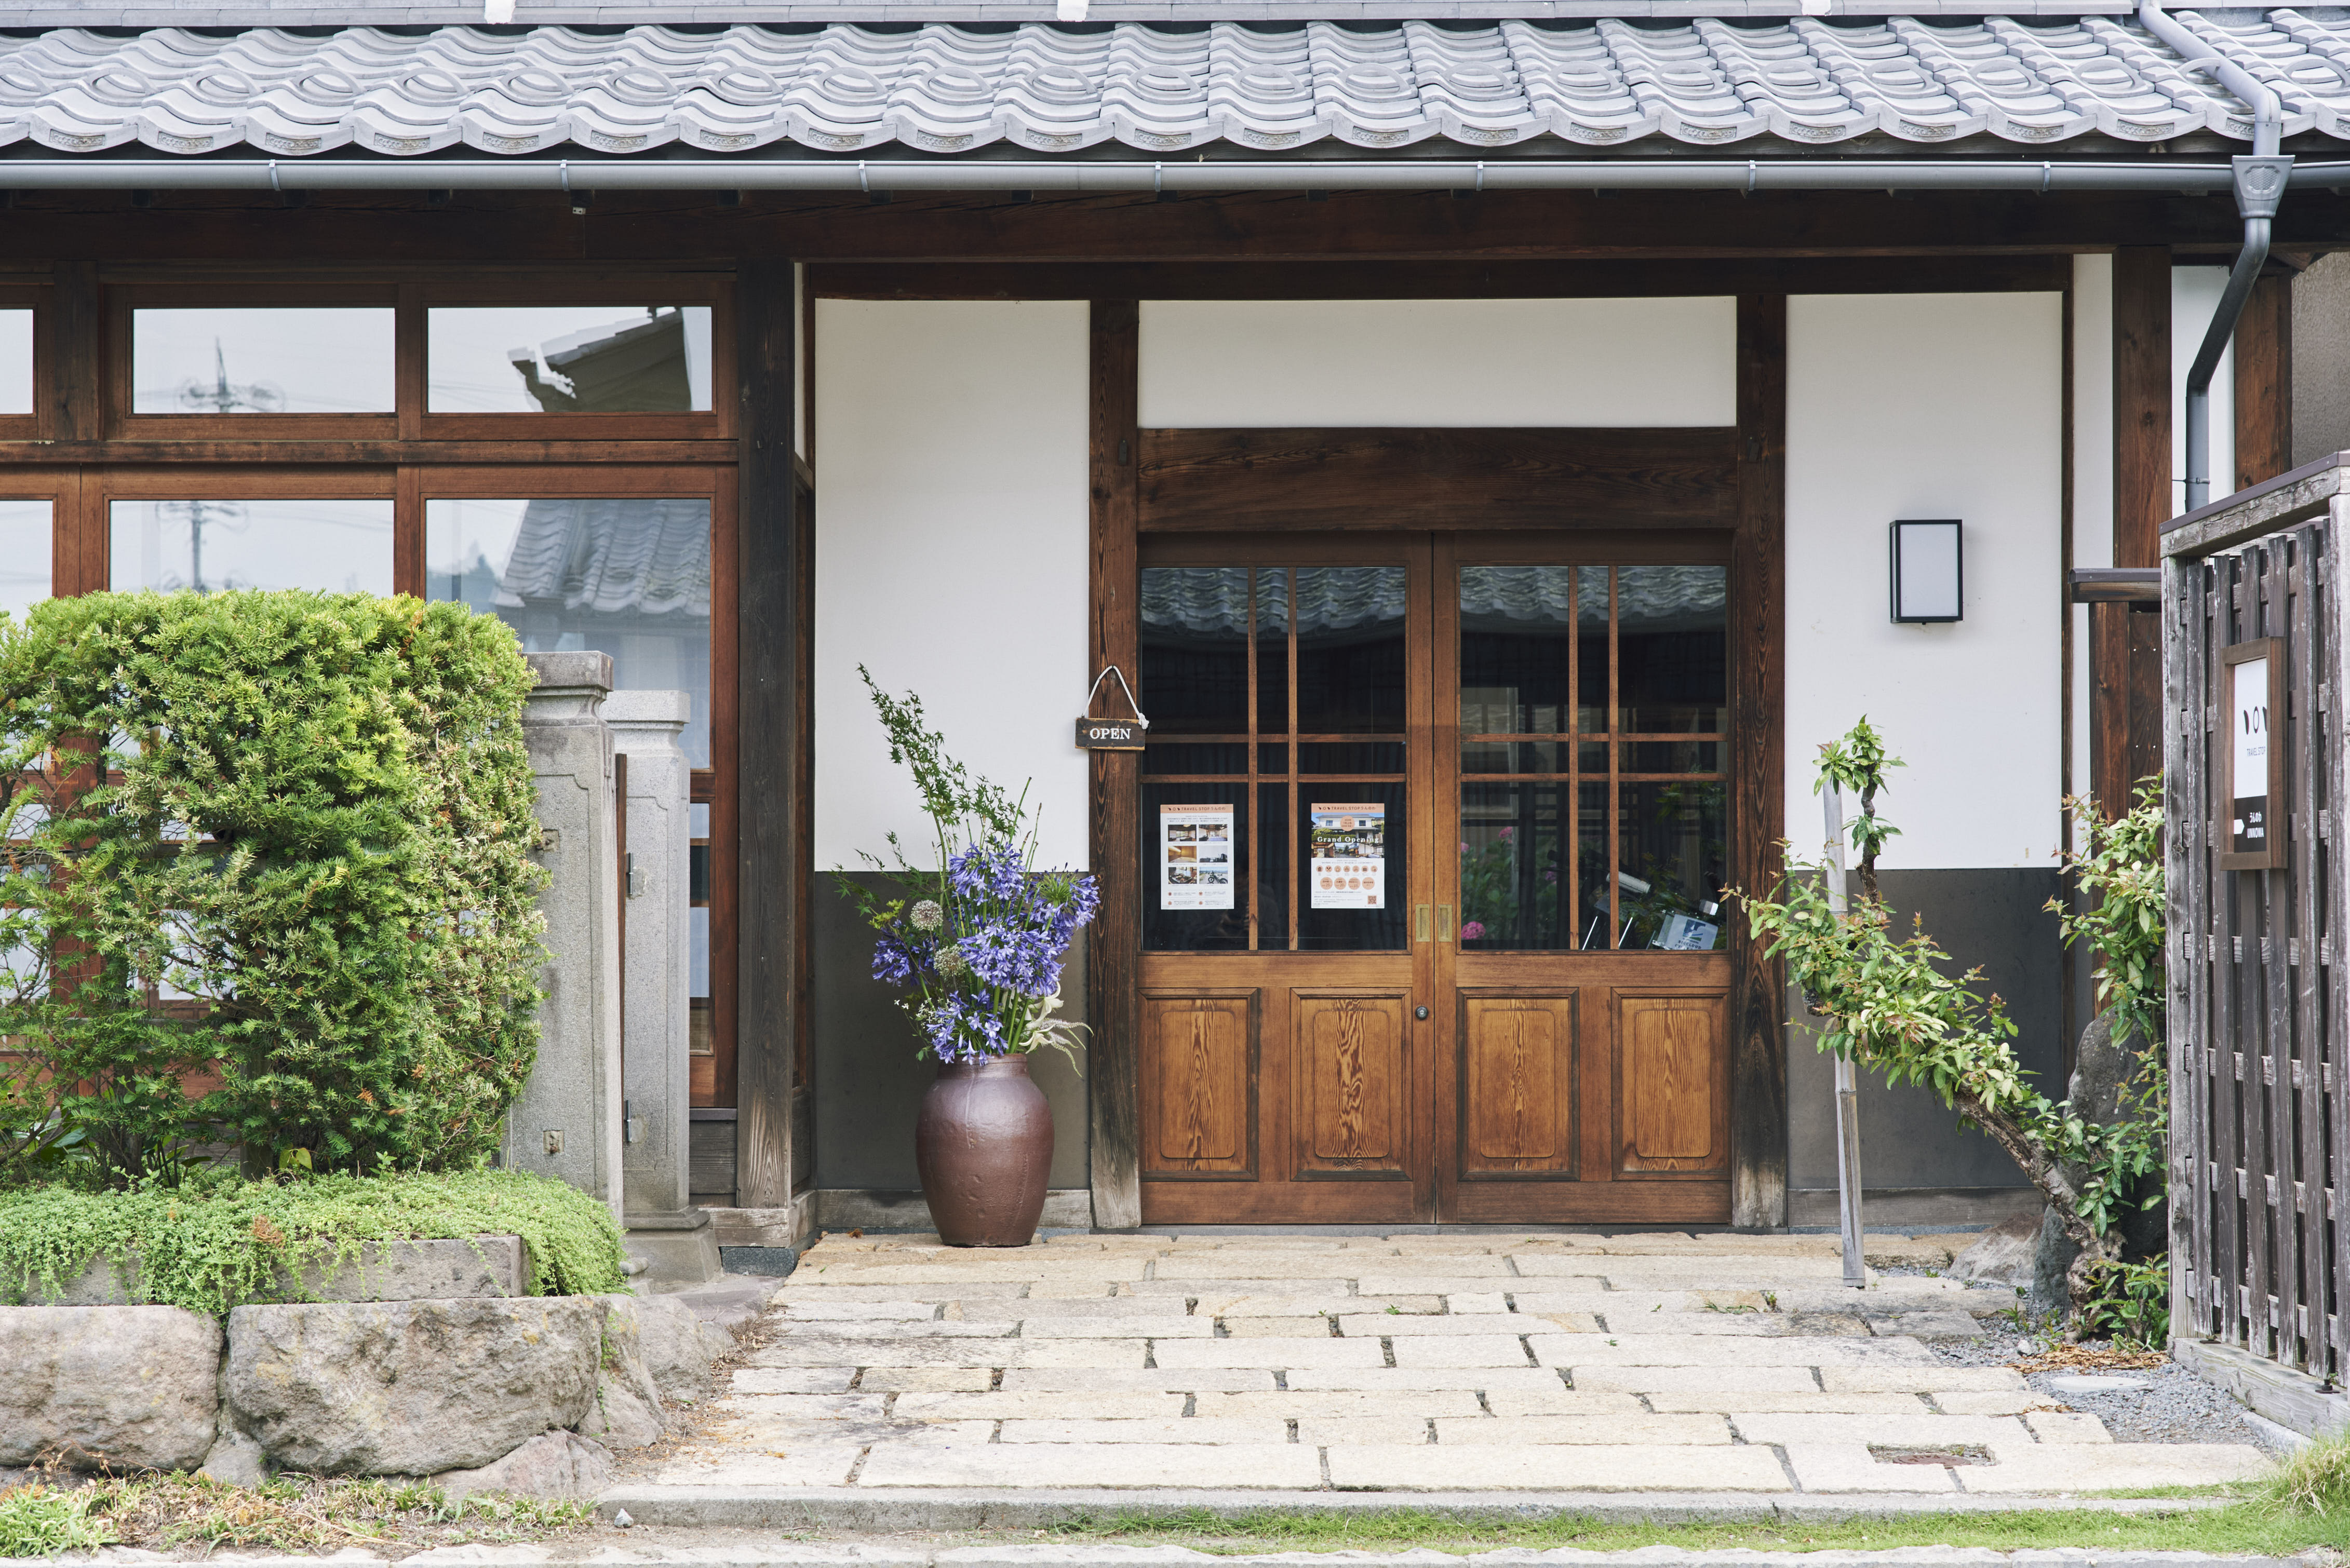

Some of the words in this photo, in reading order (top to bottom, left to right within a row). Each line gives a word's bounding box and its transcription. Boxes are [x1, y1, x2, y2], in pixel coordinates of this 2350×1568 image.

[1090, 728, 1131, 739] OPEN
[2247, 747, 2258, 756] TRAVEL
[2249, 812, 2262, 823] うんのわ
[2247, 827, 2264, 839] UNNOWA
